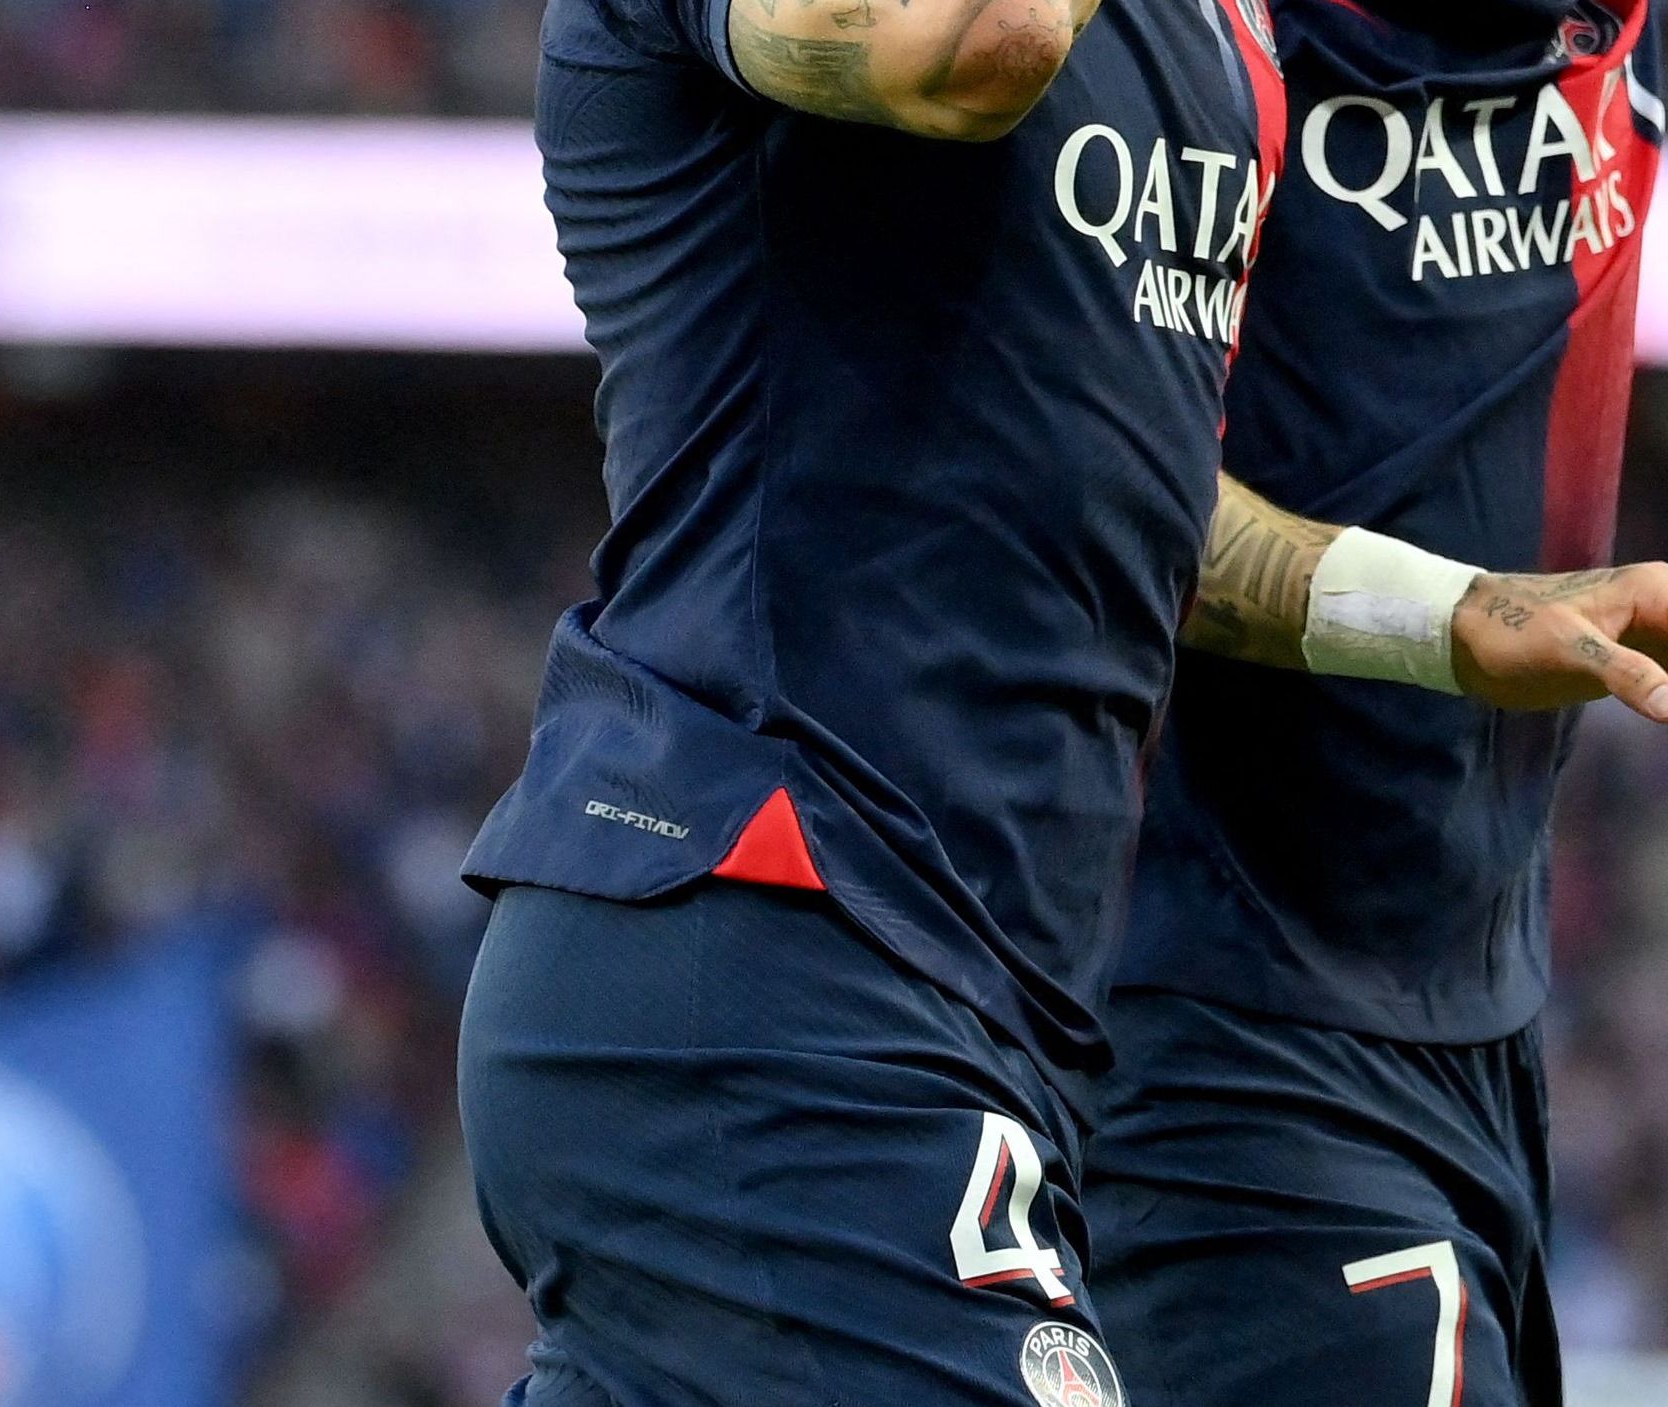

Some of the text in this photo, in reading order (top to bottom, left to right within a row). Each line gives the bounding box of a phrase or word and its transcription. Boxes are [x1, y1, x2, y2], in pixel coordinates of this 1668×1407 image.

[1054, 123, 1275, 269] QATA
[949, 1111, 1075, 1308] 4
[1029, 1327, 1091, 1358] PARIS
[1341, 1240, 1469, 1407] 7
